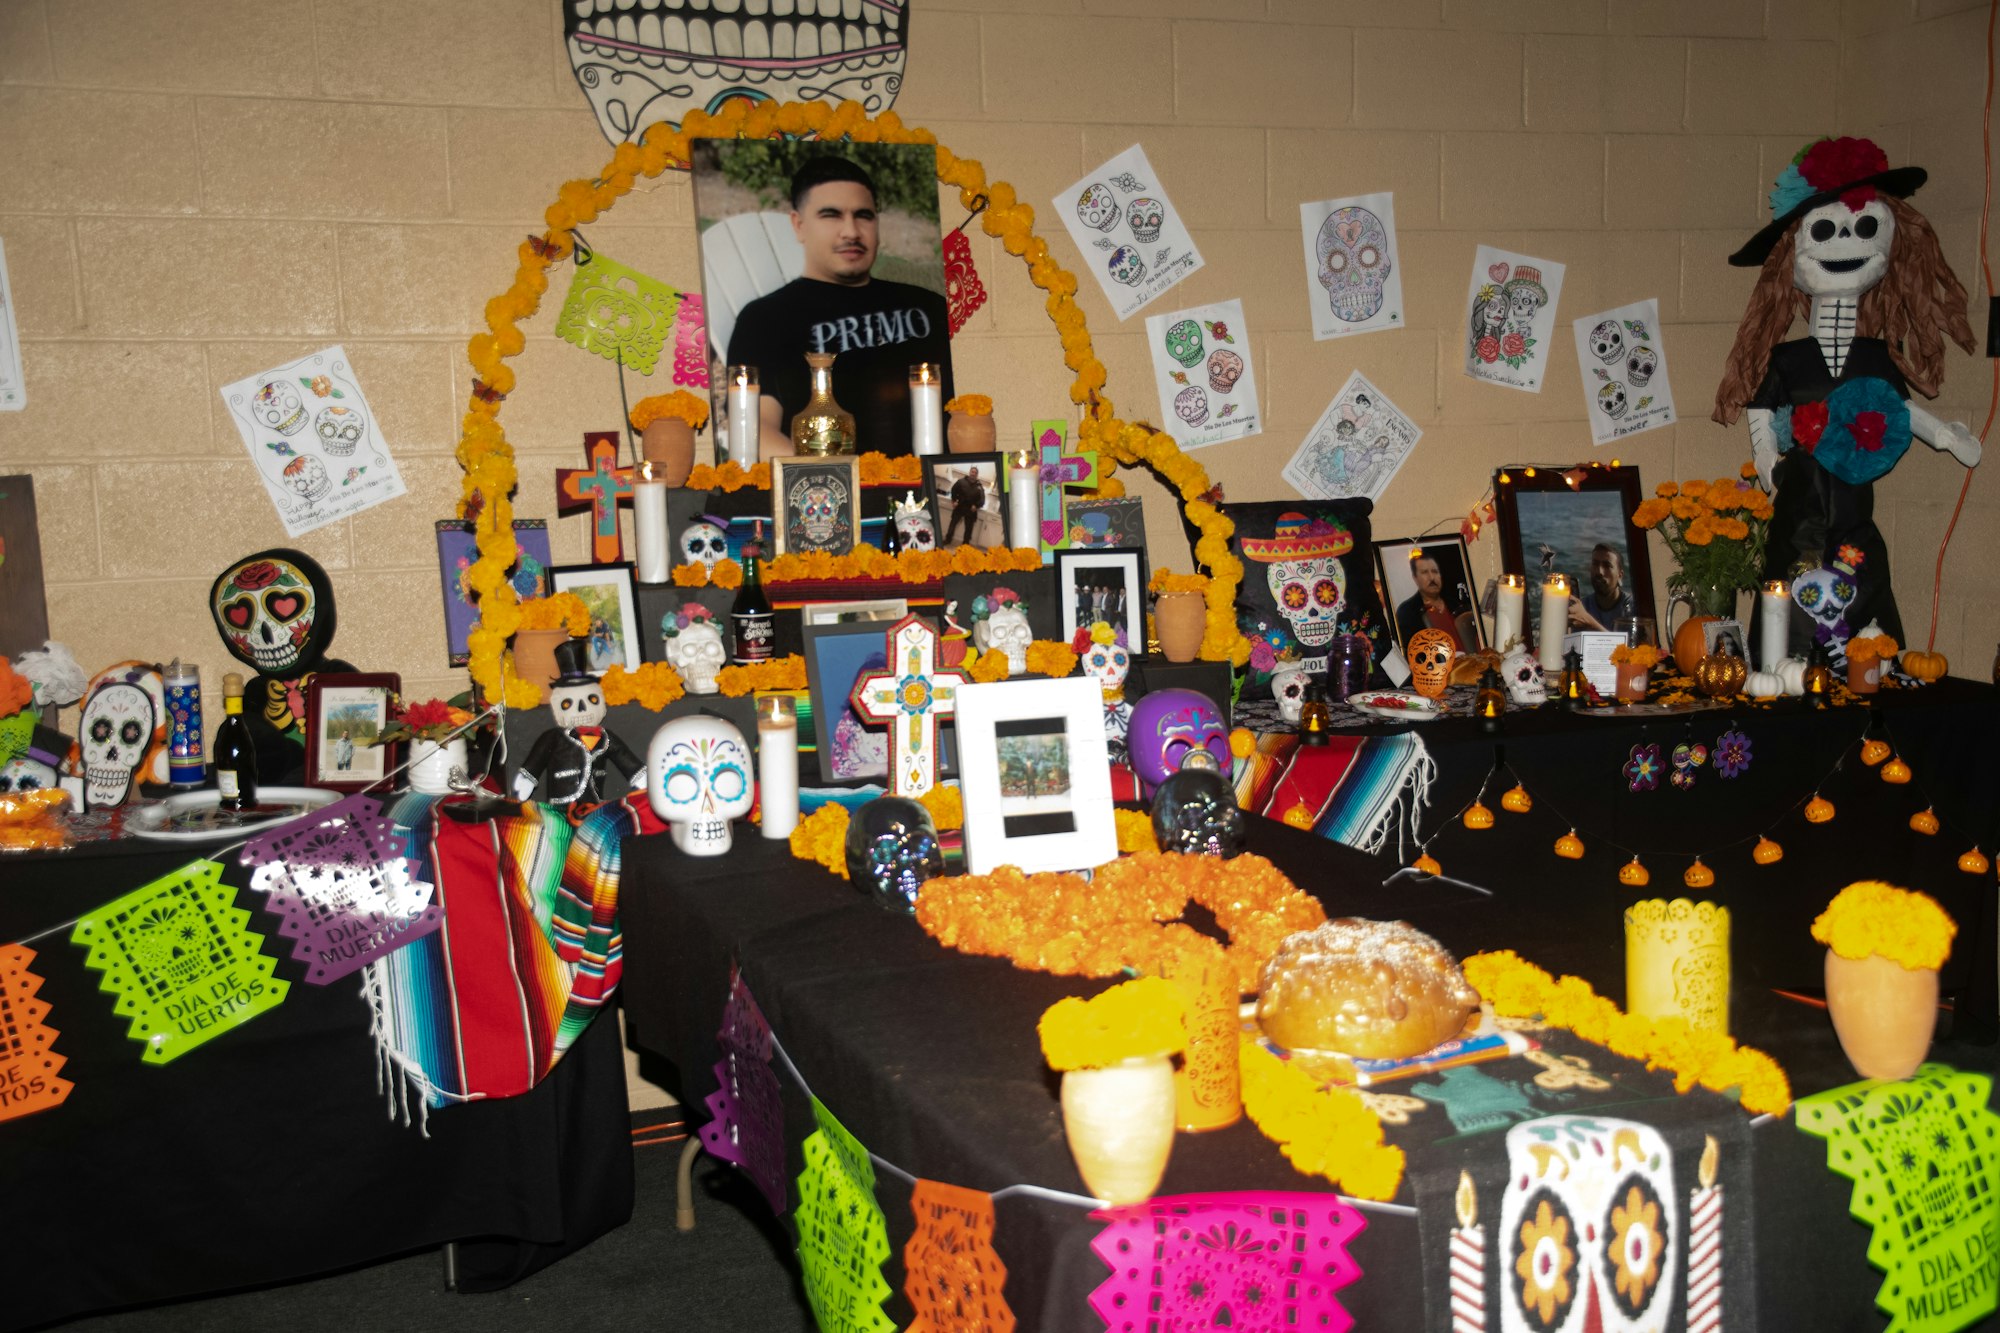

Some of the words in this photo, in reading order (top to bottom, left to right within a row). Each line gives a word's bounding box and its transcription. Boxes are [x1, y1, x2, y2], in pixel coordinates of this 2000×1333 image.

[1170, 251, 1193, 267] Muertos
[811, 308, 931, 353] PRIMO
[1222, 419, 1232, 427] Los
[1232, 415, 1255, 424] Muertos
[1649, 406, 1670, 415] Muertos
[1304, 660, 1323, 670] HOL
[319, 905, 422, 964] MUERTOS
[326, 918, 368, 944] DÍA
[165, 994, 209, 1020] DÍA
[211, 971, 243, 1000] DE
[178, 979, 265, 1034] UERTOS
[1965, 1220, 1997, 1264] DE
[839, 1287, 857, 1319] DE
[1906, 1251, 2000, 1322] MUERTO
